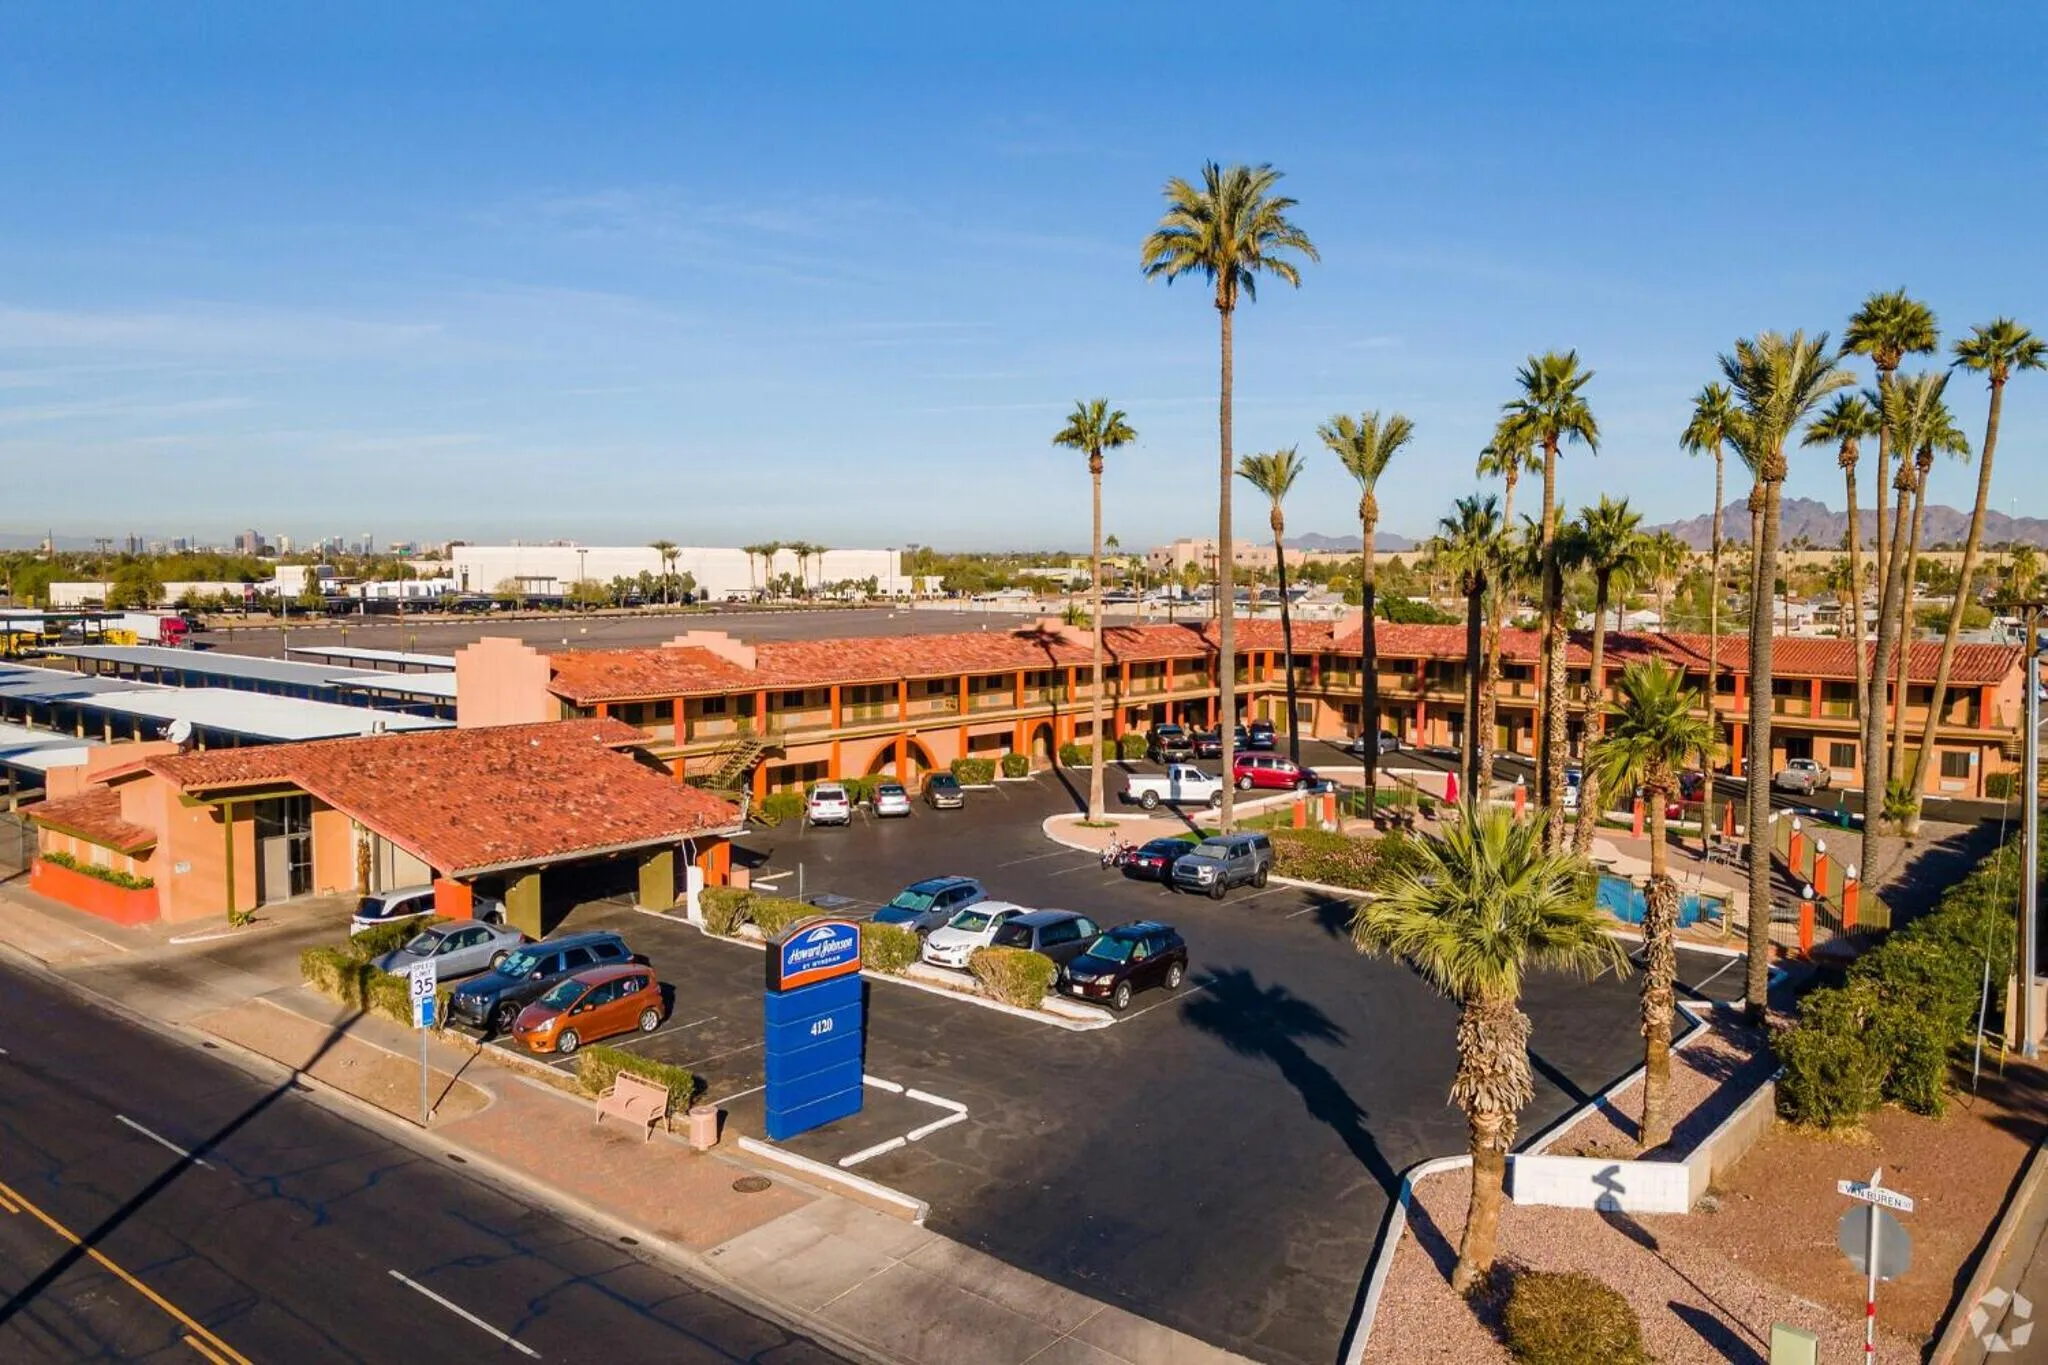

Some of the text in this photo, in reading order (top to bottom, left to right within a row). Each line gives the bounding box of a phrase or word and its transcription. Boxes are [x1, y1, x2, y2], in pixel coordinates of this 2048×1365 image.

[788, 937, 853, 964] Howard Johnson
[414, 978, 433, 995] 35
[810, 1017, 832, 1036] 4120
[1845, 1184, 1865, 1197] VAN
[1867, 1191, 1901, 1207] BUREN
